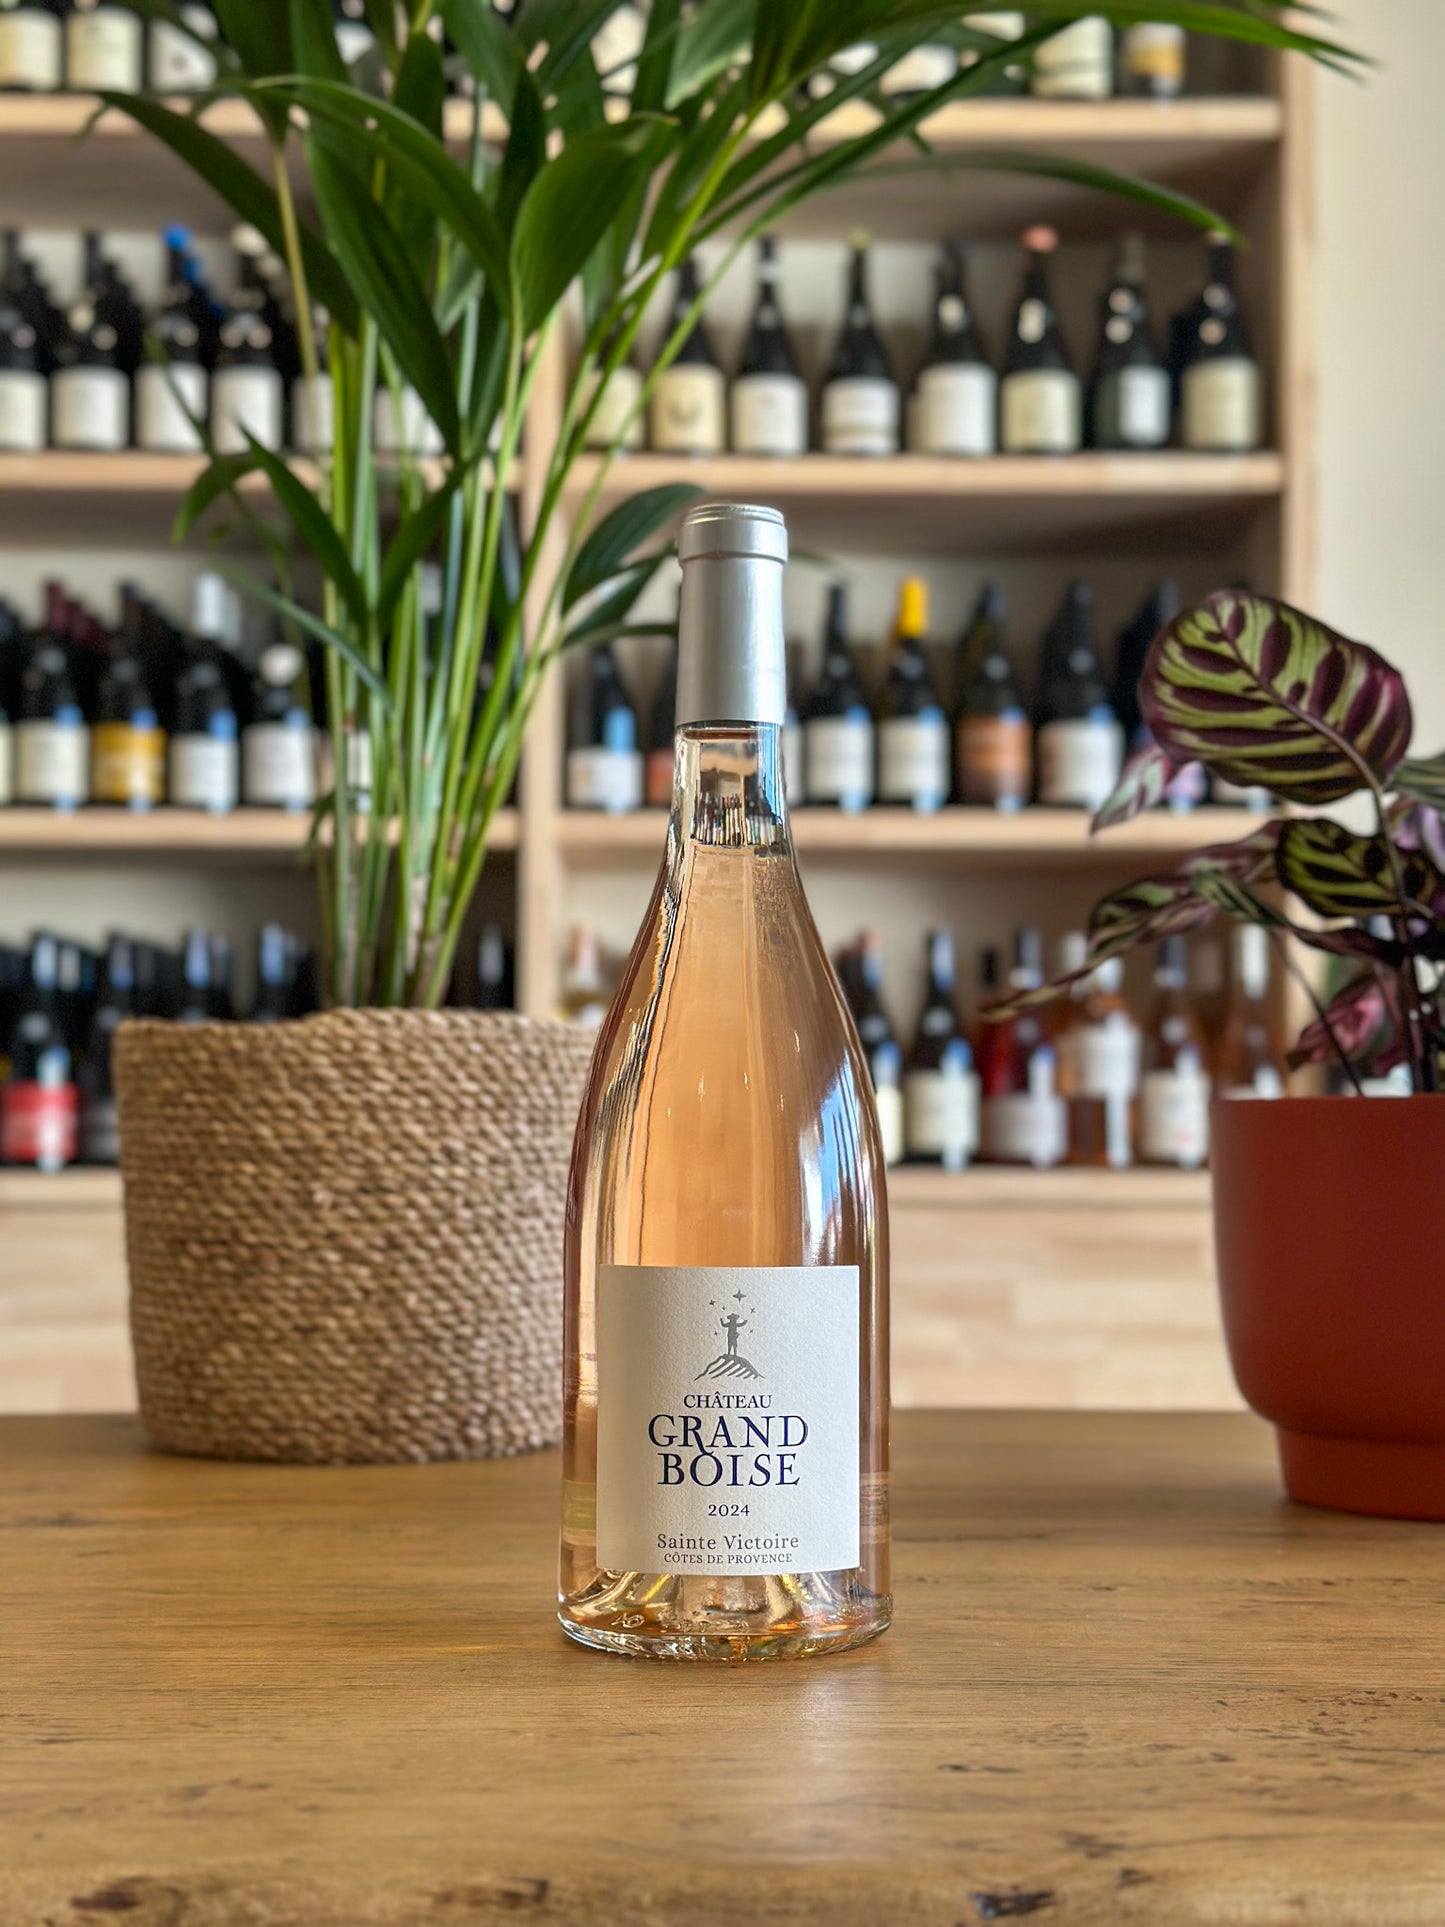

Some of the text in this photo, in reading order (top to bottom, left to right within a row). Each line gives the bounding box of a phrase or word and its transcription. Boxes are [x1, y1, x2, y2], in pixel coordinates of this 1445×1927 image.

[683, 1391, 772, 1409] CHÂTEAU
[648, 1414, 809, 1455] GRAND
[657, 1453, 801, 1487] BOISE
[708, 1504, 750, 1517] 2024
[657, 1533, 799, 1550] Sainte Victoire
[664, 1551, 793, 1564] CÔTES DE PROVENCE
